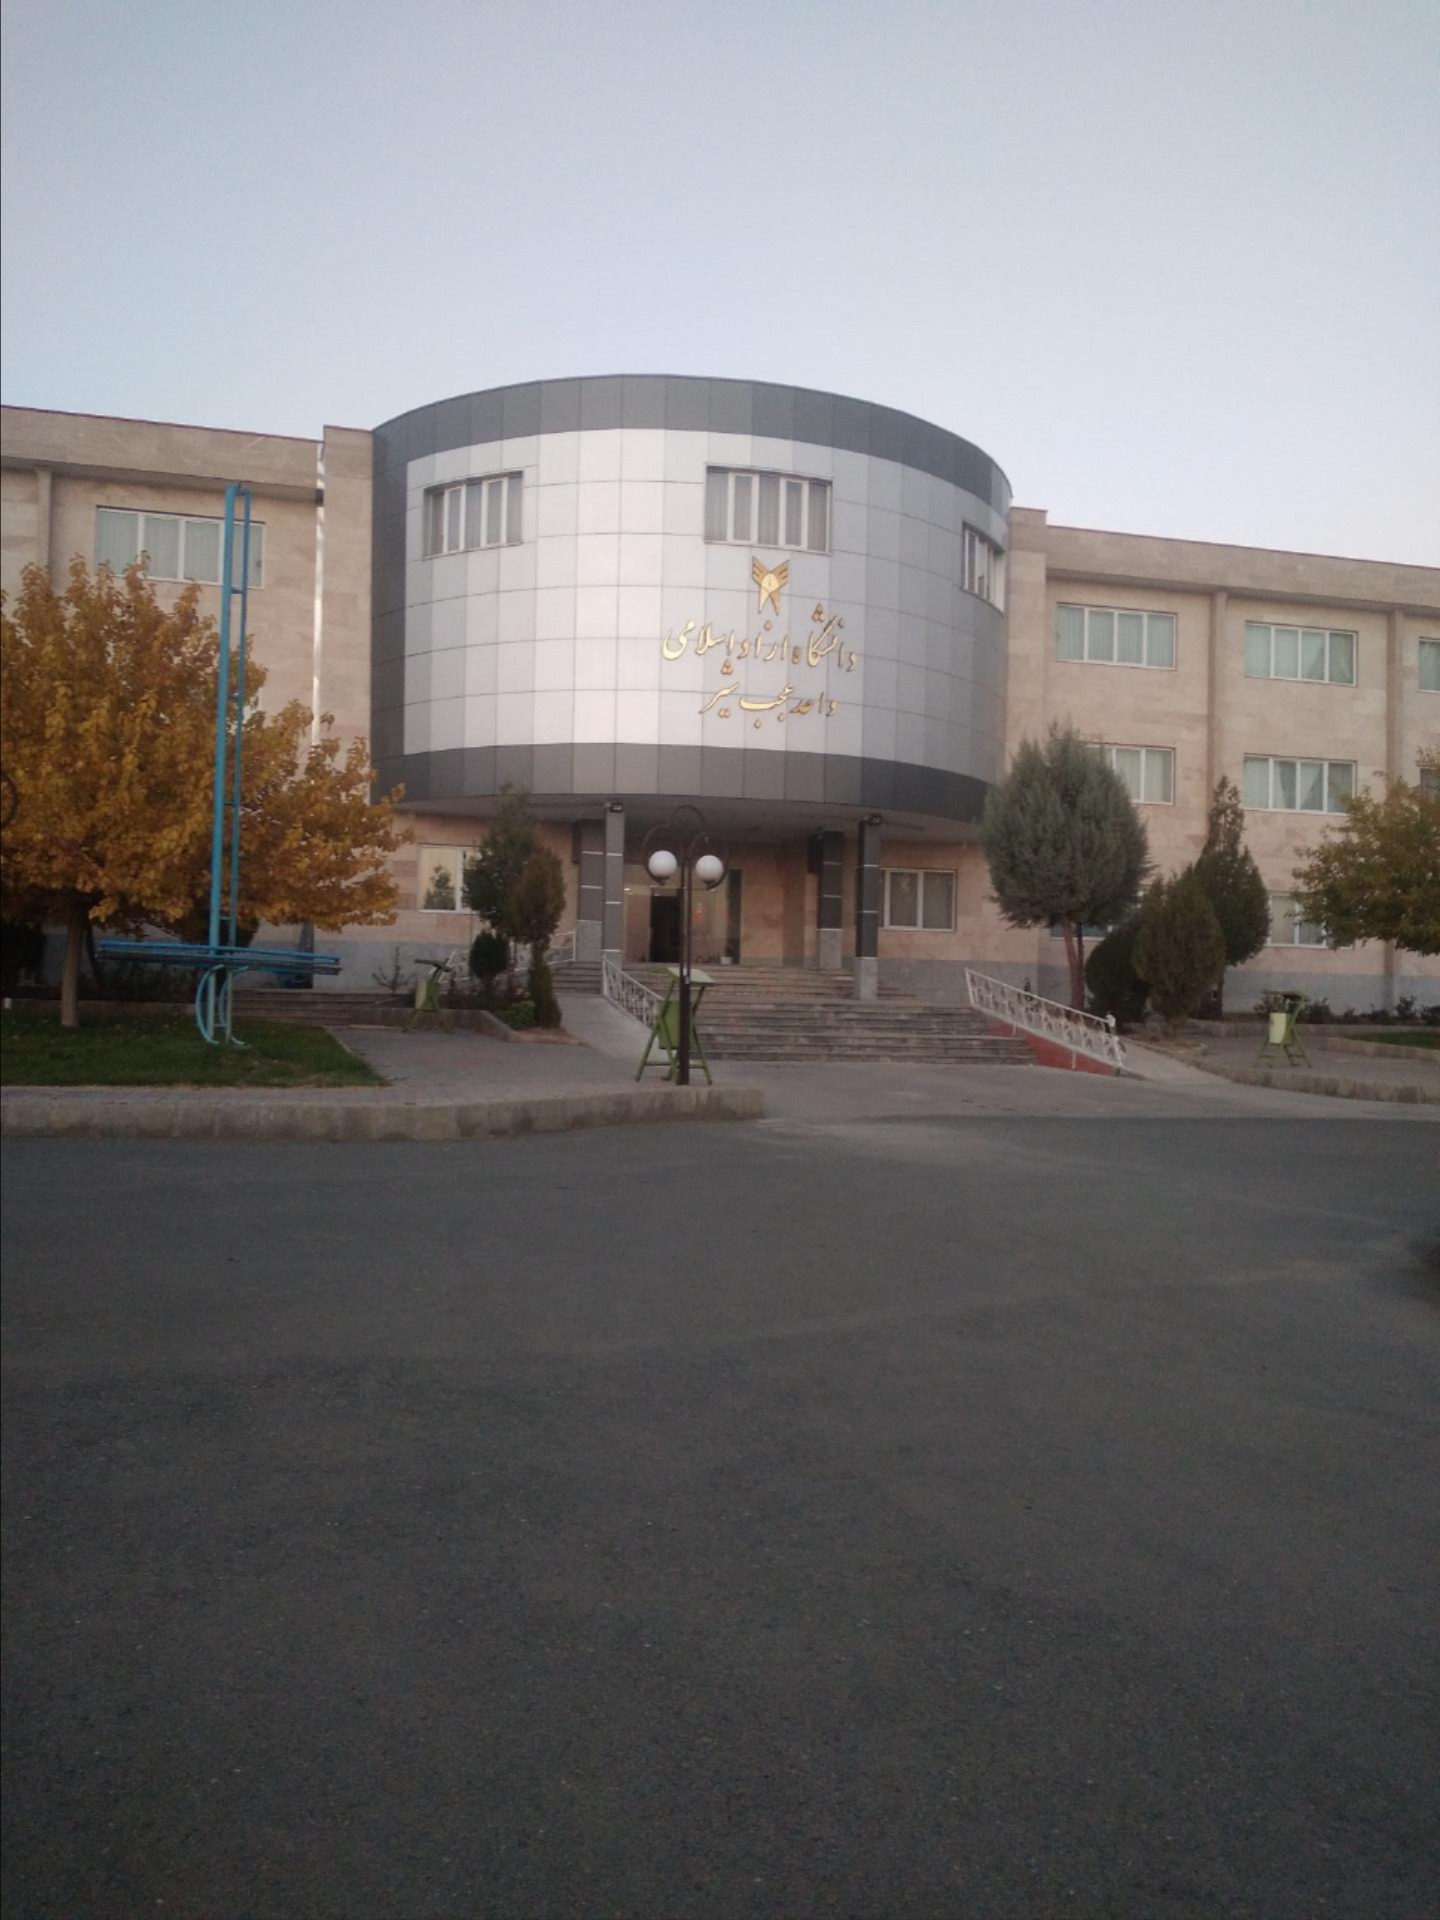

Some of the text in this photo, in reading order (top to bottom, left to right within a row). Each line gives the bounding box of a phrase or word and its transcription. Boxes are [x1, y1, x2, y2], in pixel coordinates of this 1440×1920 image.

[661, 620, 735, 661] اسلامی
[791, 603, 857, 672] دانشگاه
[790, 692, 838, 718] واحد
